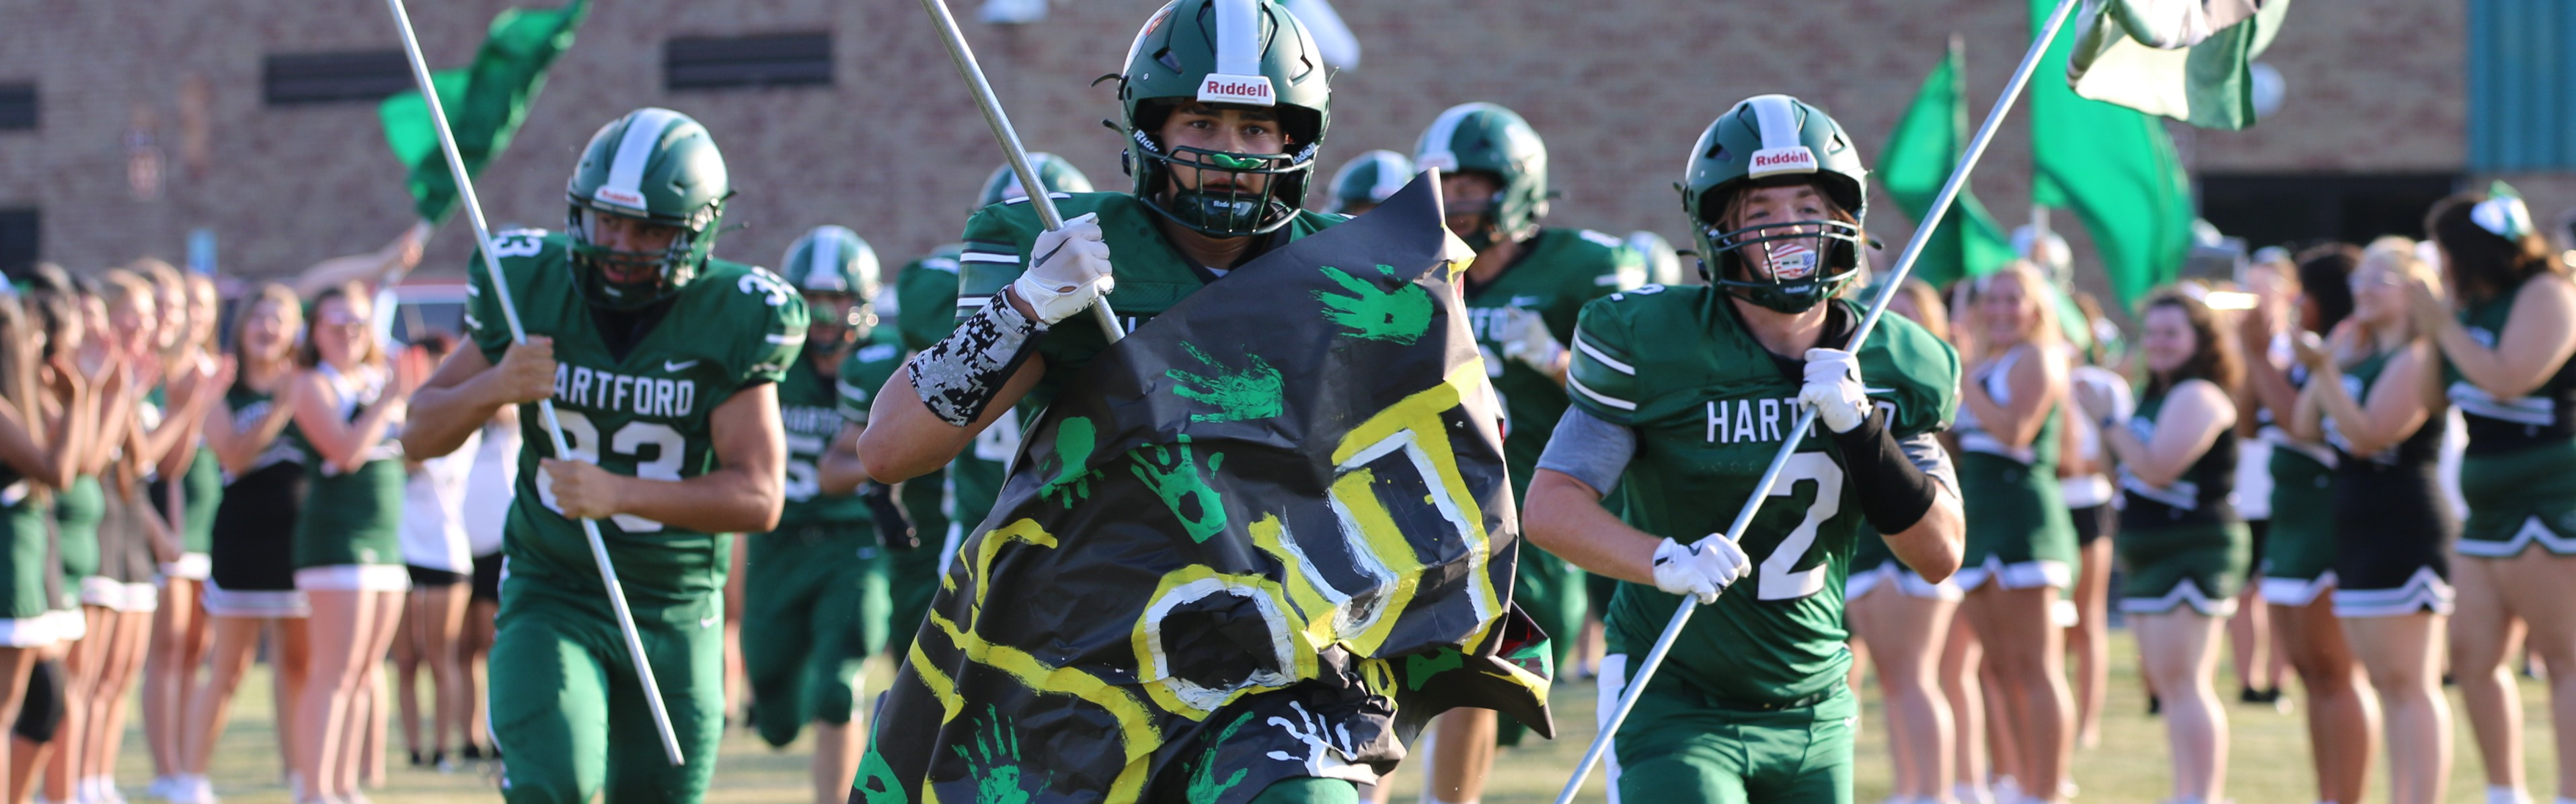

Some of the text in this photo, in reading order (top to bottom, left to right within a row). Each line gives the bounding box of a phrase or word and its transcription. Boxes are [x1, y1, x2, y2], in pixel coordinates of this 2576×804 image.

[1207, 81, 1268, 97] Riddell
[1755, 152, 1809, 166] Riddell
[553, 362, 694, 417] ARTFORD
[1757, 450, 1844, 600] 2
